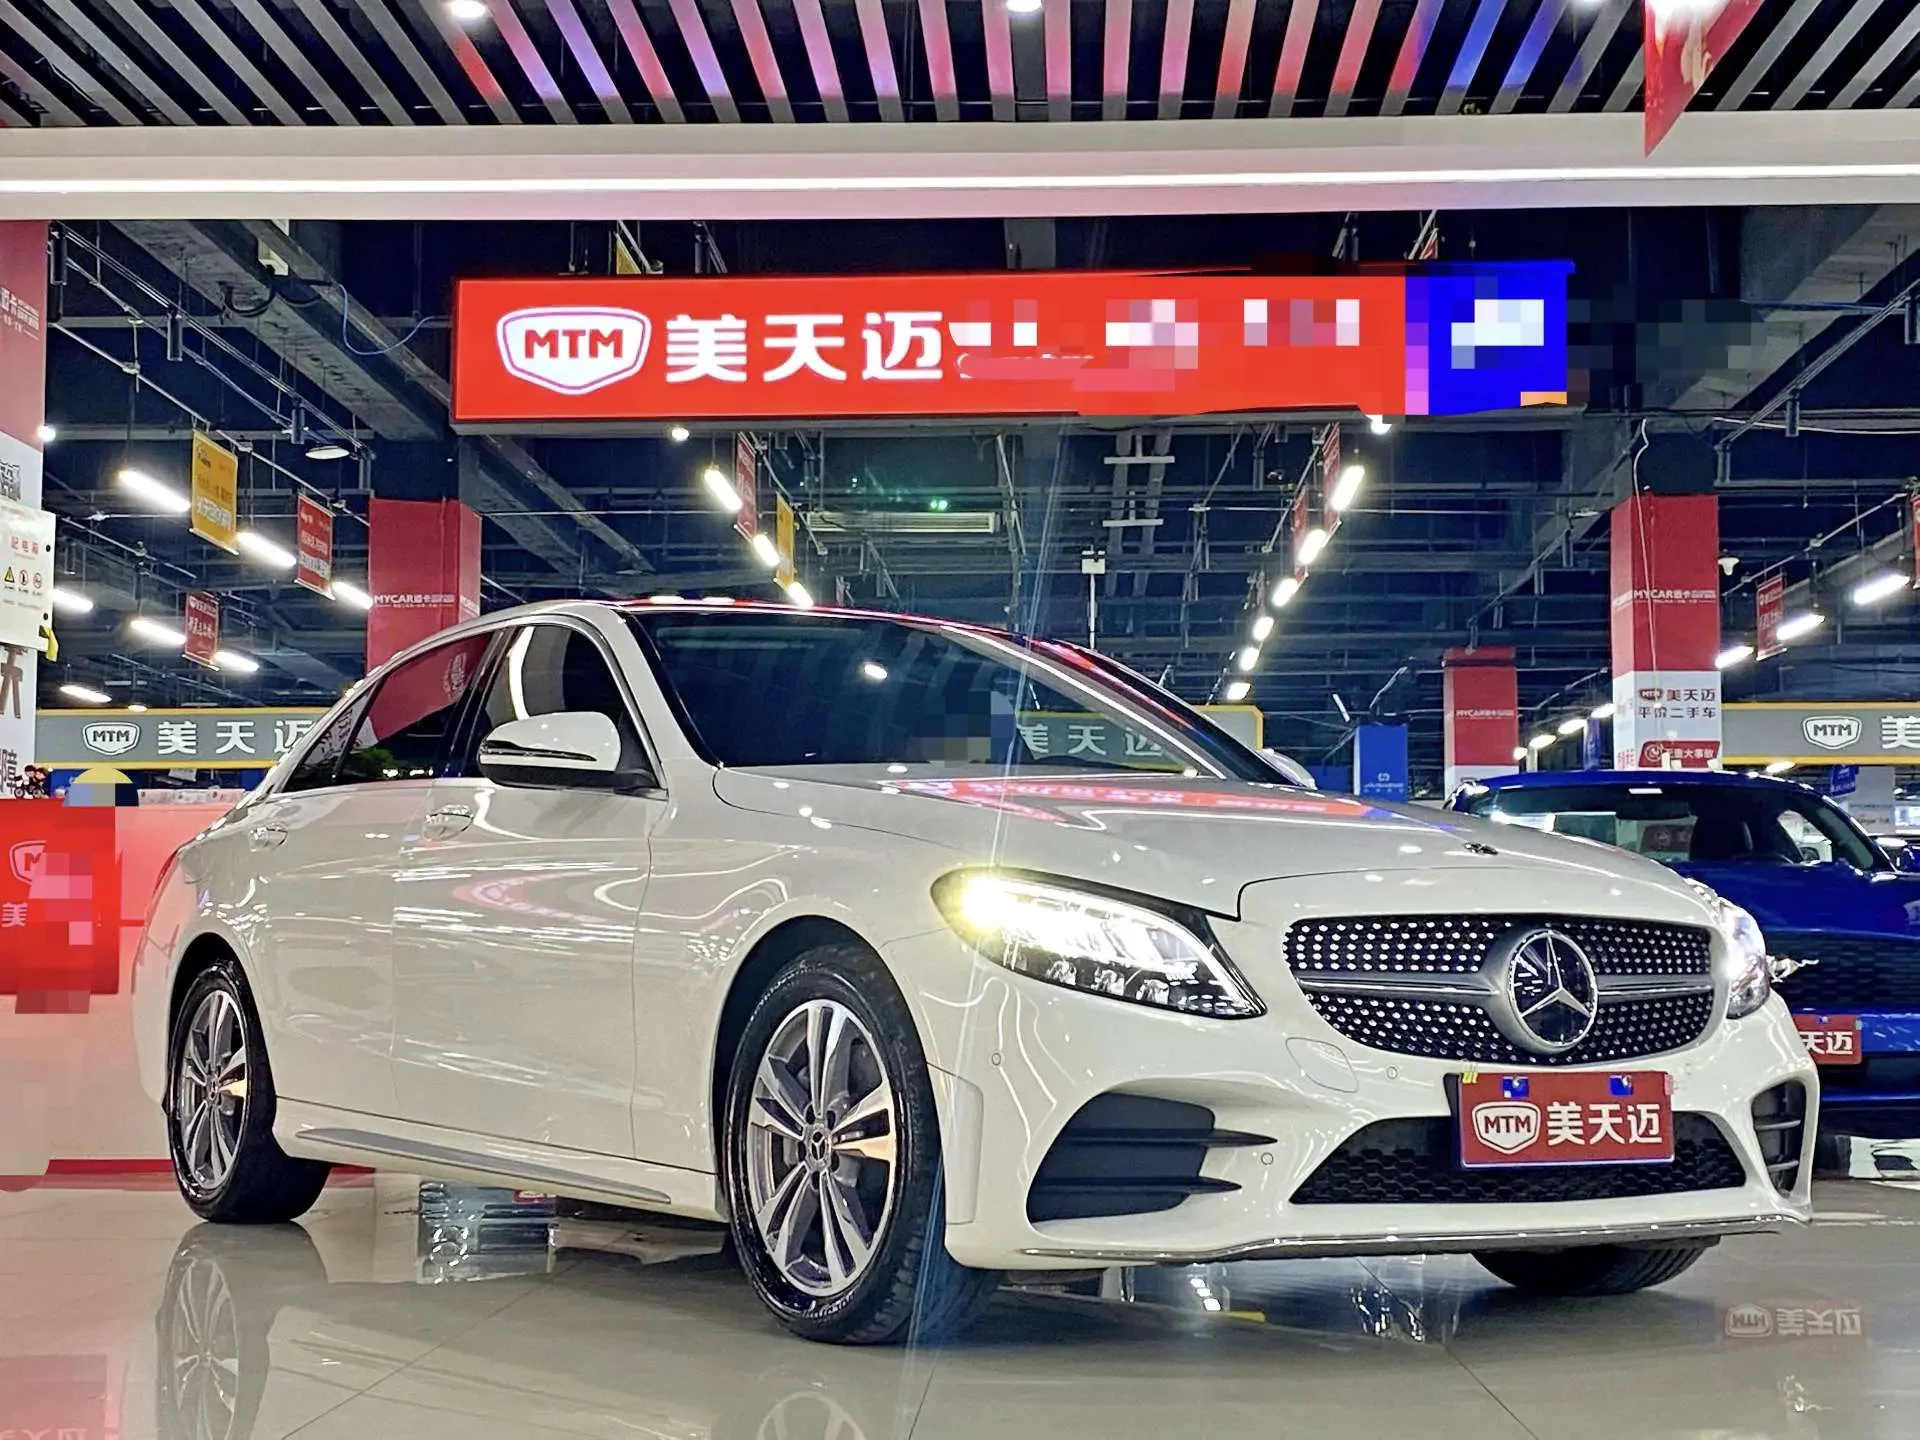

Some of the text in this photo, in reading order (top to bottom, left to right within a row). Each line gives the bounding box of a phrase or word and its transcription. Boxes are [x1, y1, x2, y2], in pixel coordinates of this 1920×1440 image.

[525, 311, 944, 383] MTM 美天迈
[1666, 687, 1716, 702] 美天迈
[1638, 705, 1716, 719] 平价二手车
[93, 730, 130, 743] MTM
[1813, 724, 1852, 737] MTM
[1484, 1101, 1663, 1146] MTM 美天迈
